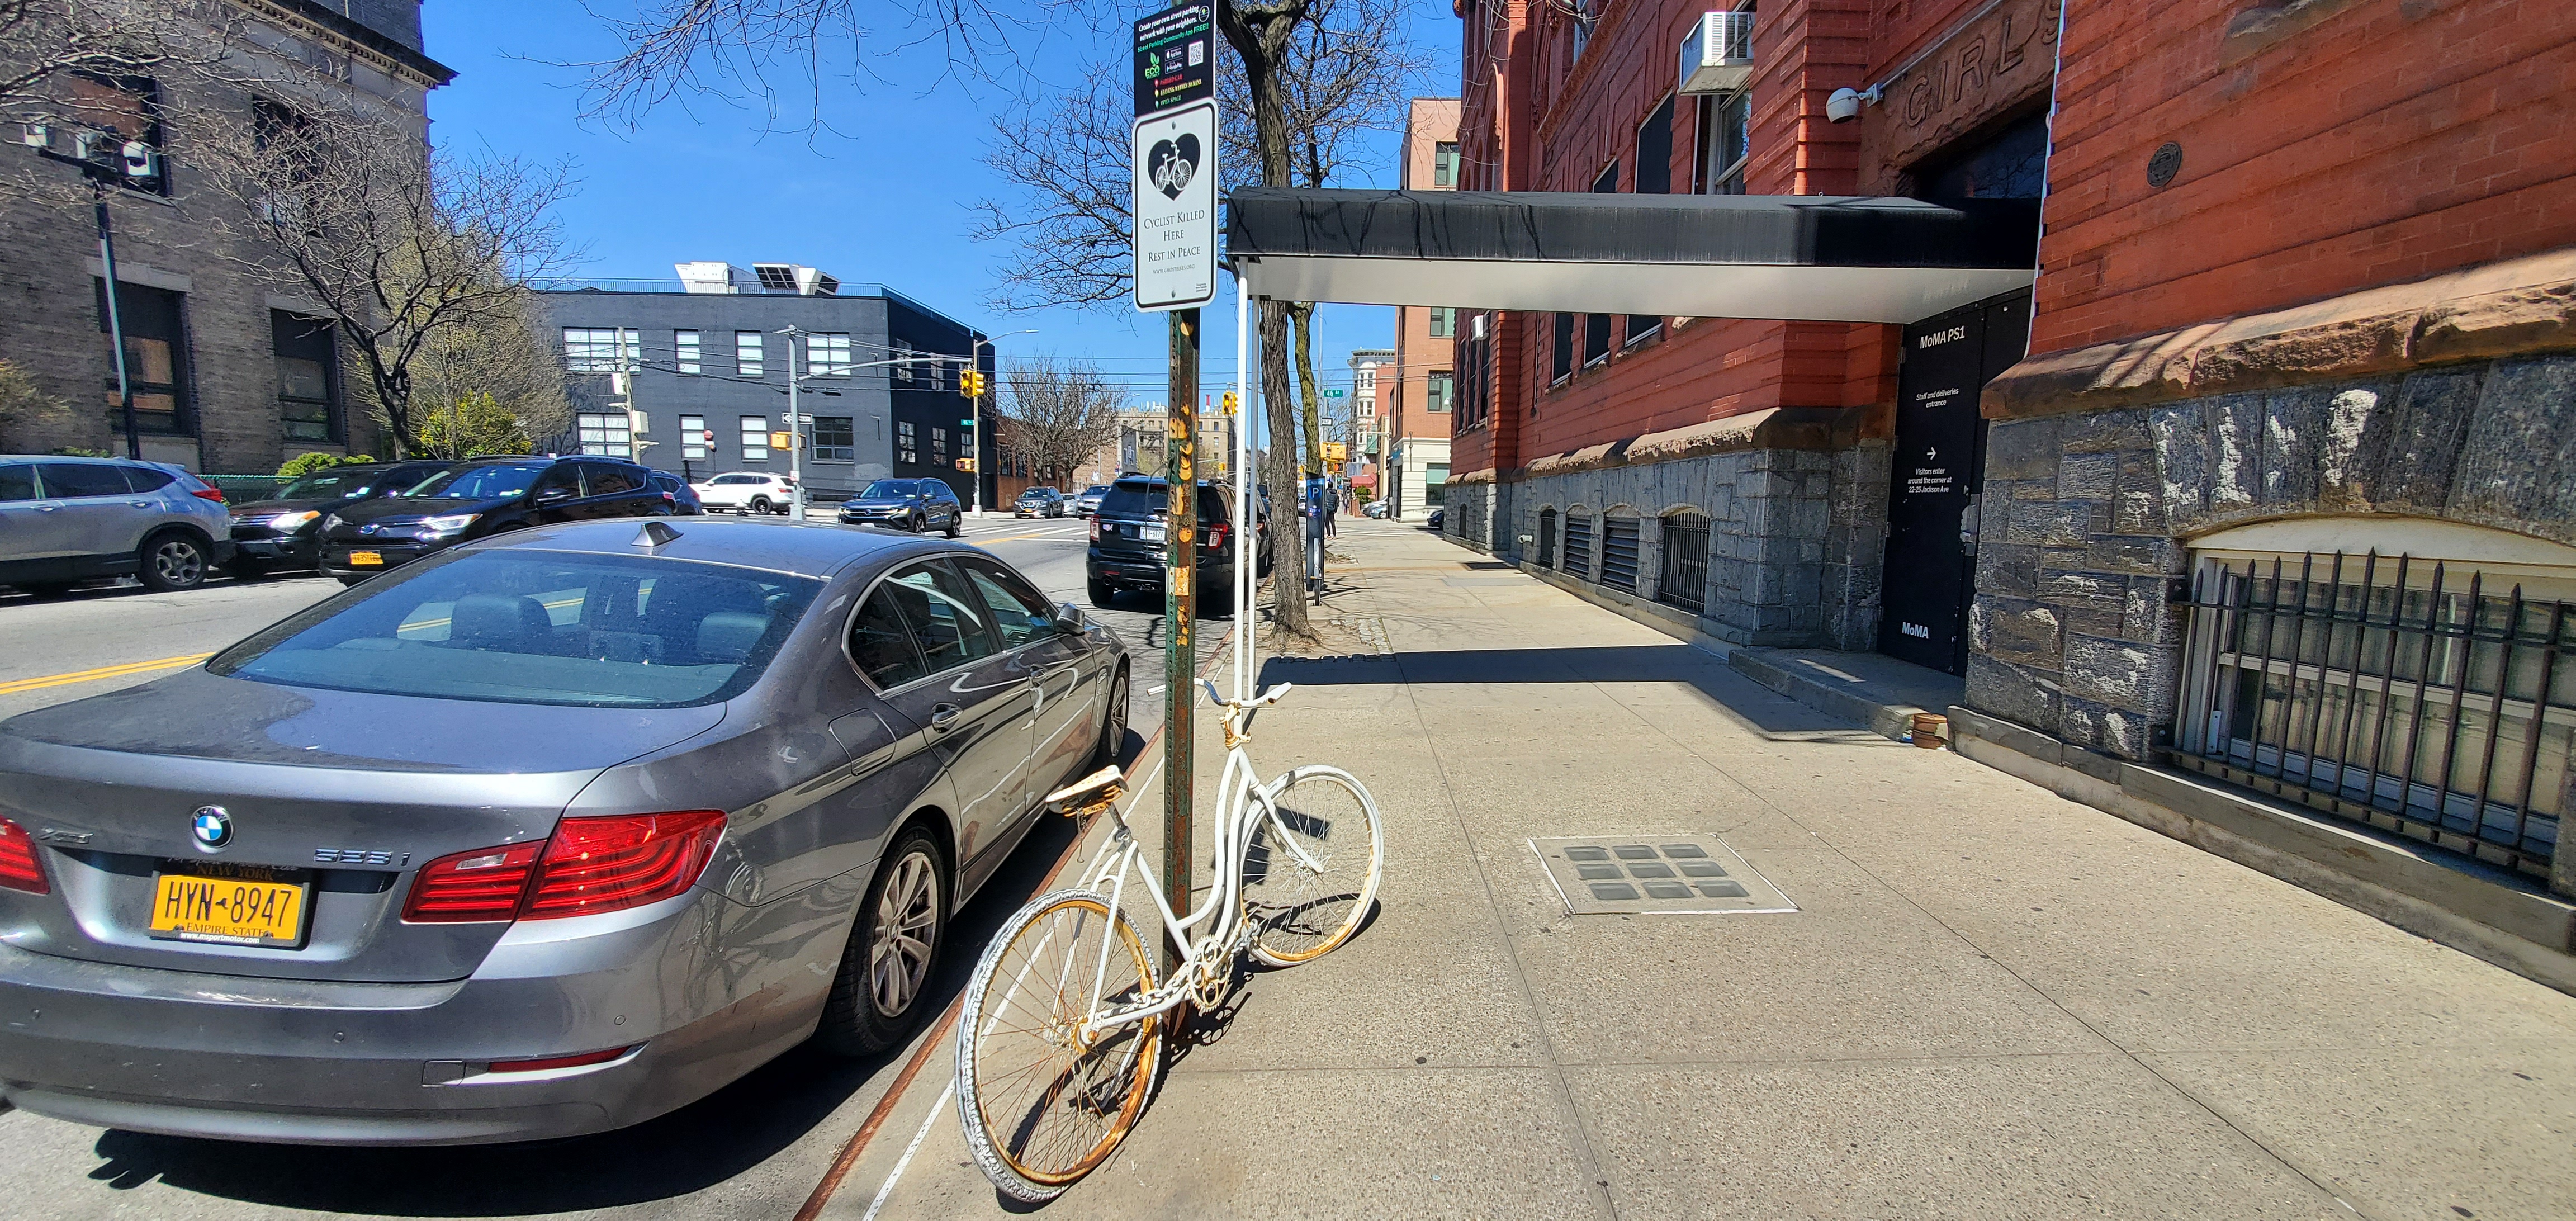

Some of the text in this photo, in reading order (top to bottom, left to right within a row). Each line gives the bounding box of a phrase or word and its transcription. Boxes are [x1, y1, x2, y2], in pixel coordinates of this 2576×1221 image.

[1139, 6, 1200, 32] Create your own street parking
[1139, 29, 1156, 41] network
[1156, 26, 1166, 36] with
[1165, 24, 1176, 34] your
[1138, 44, 1149, 53] Street
[1149, 39, 1163, 49] Parking
[1163, 32, 1185, 43] Community
[1145, 65, 1160, 77] ECO
[1160, 86, 1175, 96] LEAVING
[1170, 94, 1181, 103] SPACE
[1144, 210, 1205, 229] CYCLIST KILLED
[1163, 229, 1184, 242] HERE
[1148, 246, 1200, 262] REST IN PEACE
[1920, 325, 1965, 349] MoMA PS1
[1916, 392, 1928, 400] Staff
[1936, 387, 1959, 397] deliveries
[1926, 400, 1947, 408] entrance
[1902, 622, 1929, 639] MoMA
[186, 922, 229, 935] EMPIRE
[179, 932, 261, 944] www.msportmotor.com
